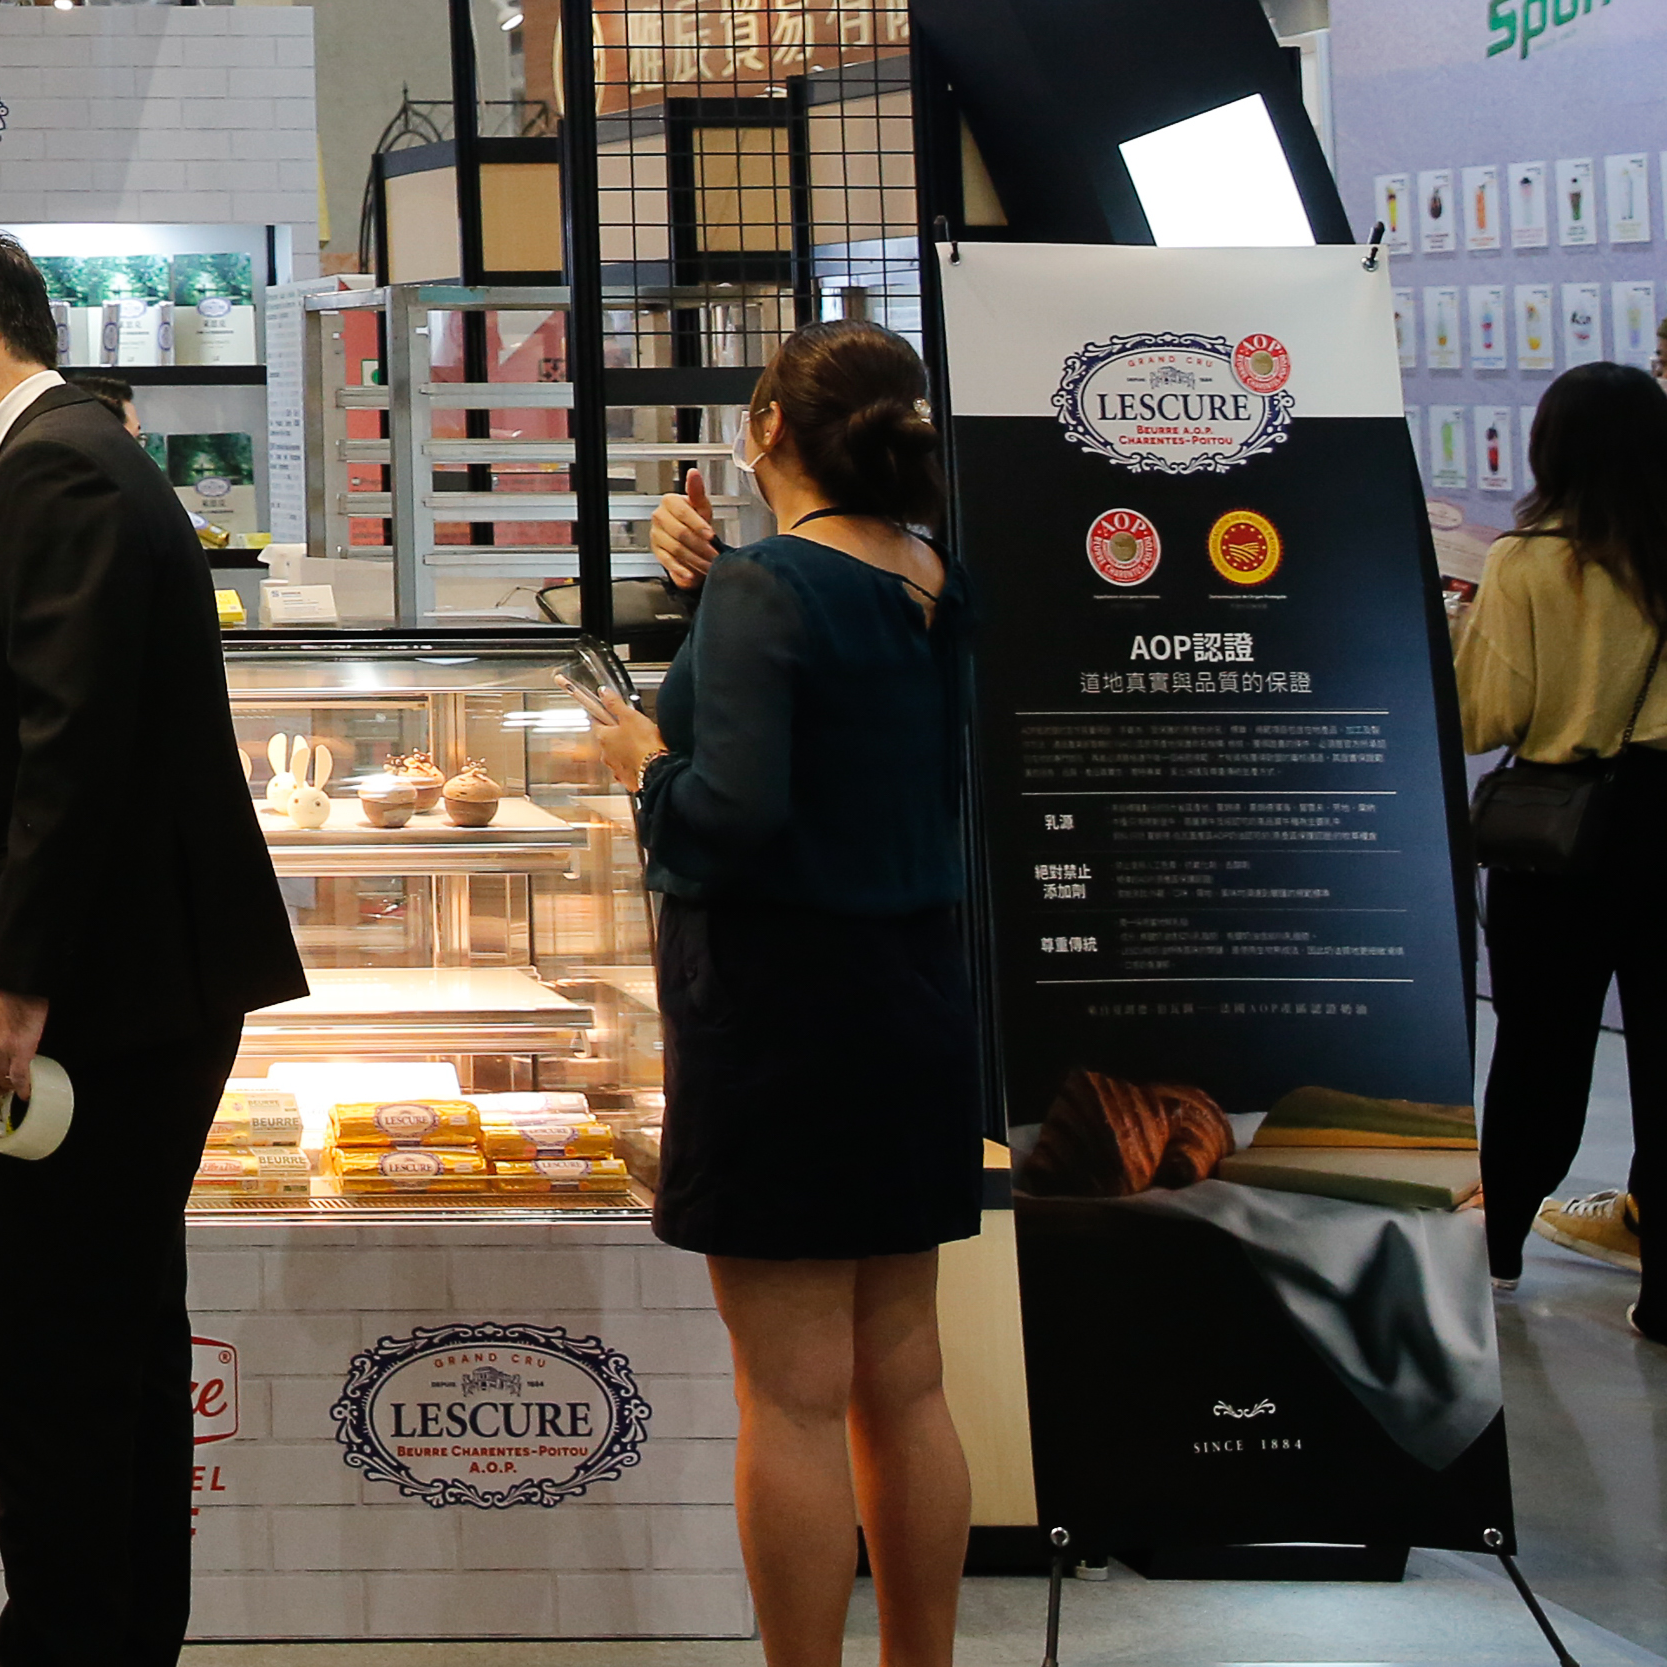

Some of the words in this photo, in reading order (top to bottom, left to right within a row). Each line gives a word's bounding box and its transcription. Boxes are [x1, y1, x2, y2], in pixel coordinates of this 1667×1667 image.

[1128, 355, 1176, 367] GRAND
[1186, 356, 1214, 368] CRU
[1097, 393, 1251, 421] LESCURE
[1099, 512, 1148, 533] AOP
[1130, 632, 1255, 663] AOP認證
[1079, 670, 1313, 696] 道地真實與品質的保證
[1044, 814, 1074, 830] 乳源
[1034, 864, 1092, 881] 絕對禁止
[1043, 883, 1087, 899] 添加劑
[1040, 936, 1098, 953] 尊重傳統
[252, 1117, 300, 1128] BEURRE
[385, 1114, 428, 1125] LESCURE
[259, 1154, 307, 1165] BEURRE
[389, 1163, 433, 1173] LESCURE
[434, 1353, 498, 1368] GRAND
[511, 1353, 547, 1368] CRU
[390, 1402, 593, 1438] LESCURE
[1193, 1439, 1244, 1454] SINCE
[1261, 1438, 1303, 1451] 1884
[469, 1461, 517, 1474] A.O.P.
